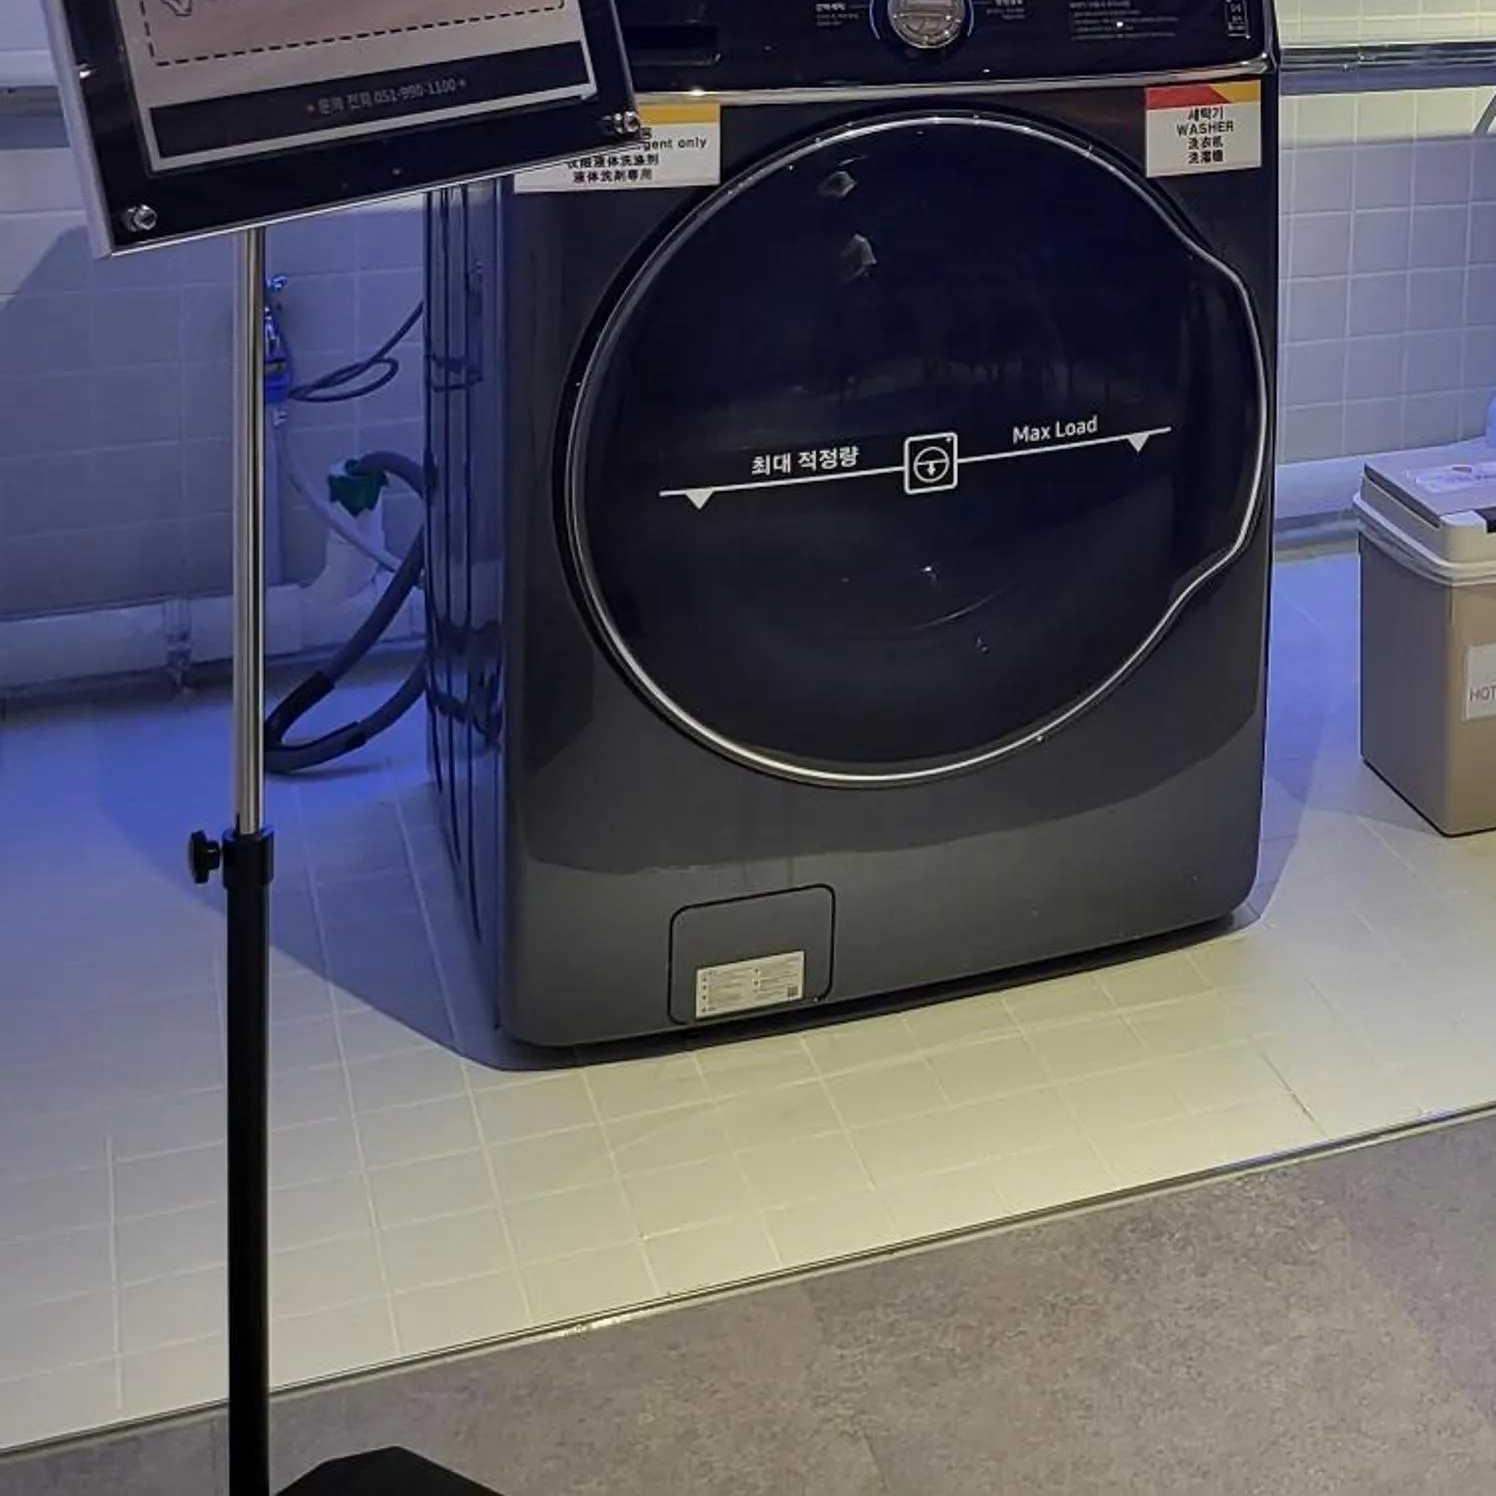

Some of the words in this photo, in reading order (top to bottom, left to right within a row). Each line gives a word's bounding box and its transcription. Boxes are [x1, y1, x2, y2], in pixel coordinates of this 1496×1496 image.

[1187, 105, 1224, 122] 세탁기
[1176, 119, 1234, 137] WASHER
[678, 136, 708, 149] only
[1013, 422, 1053, 444] Max
[1055, 414, 1099, 439] Load
[751, 450, 793, 477] 최대
[797, 444, 860, 473] 적정량
